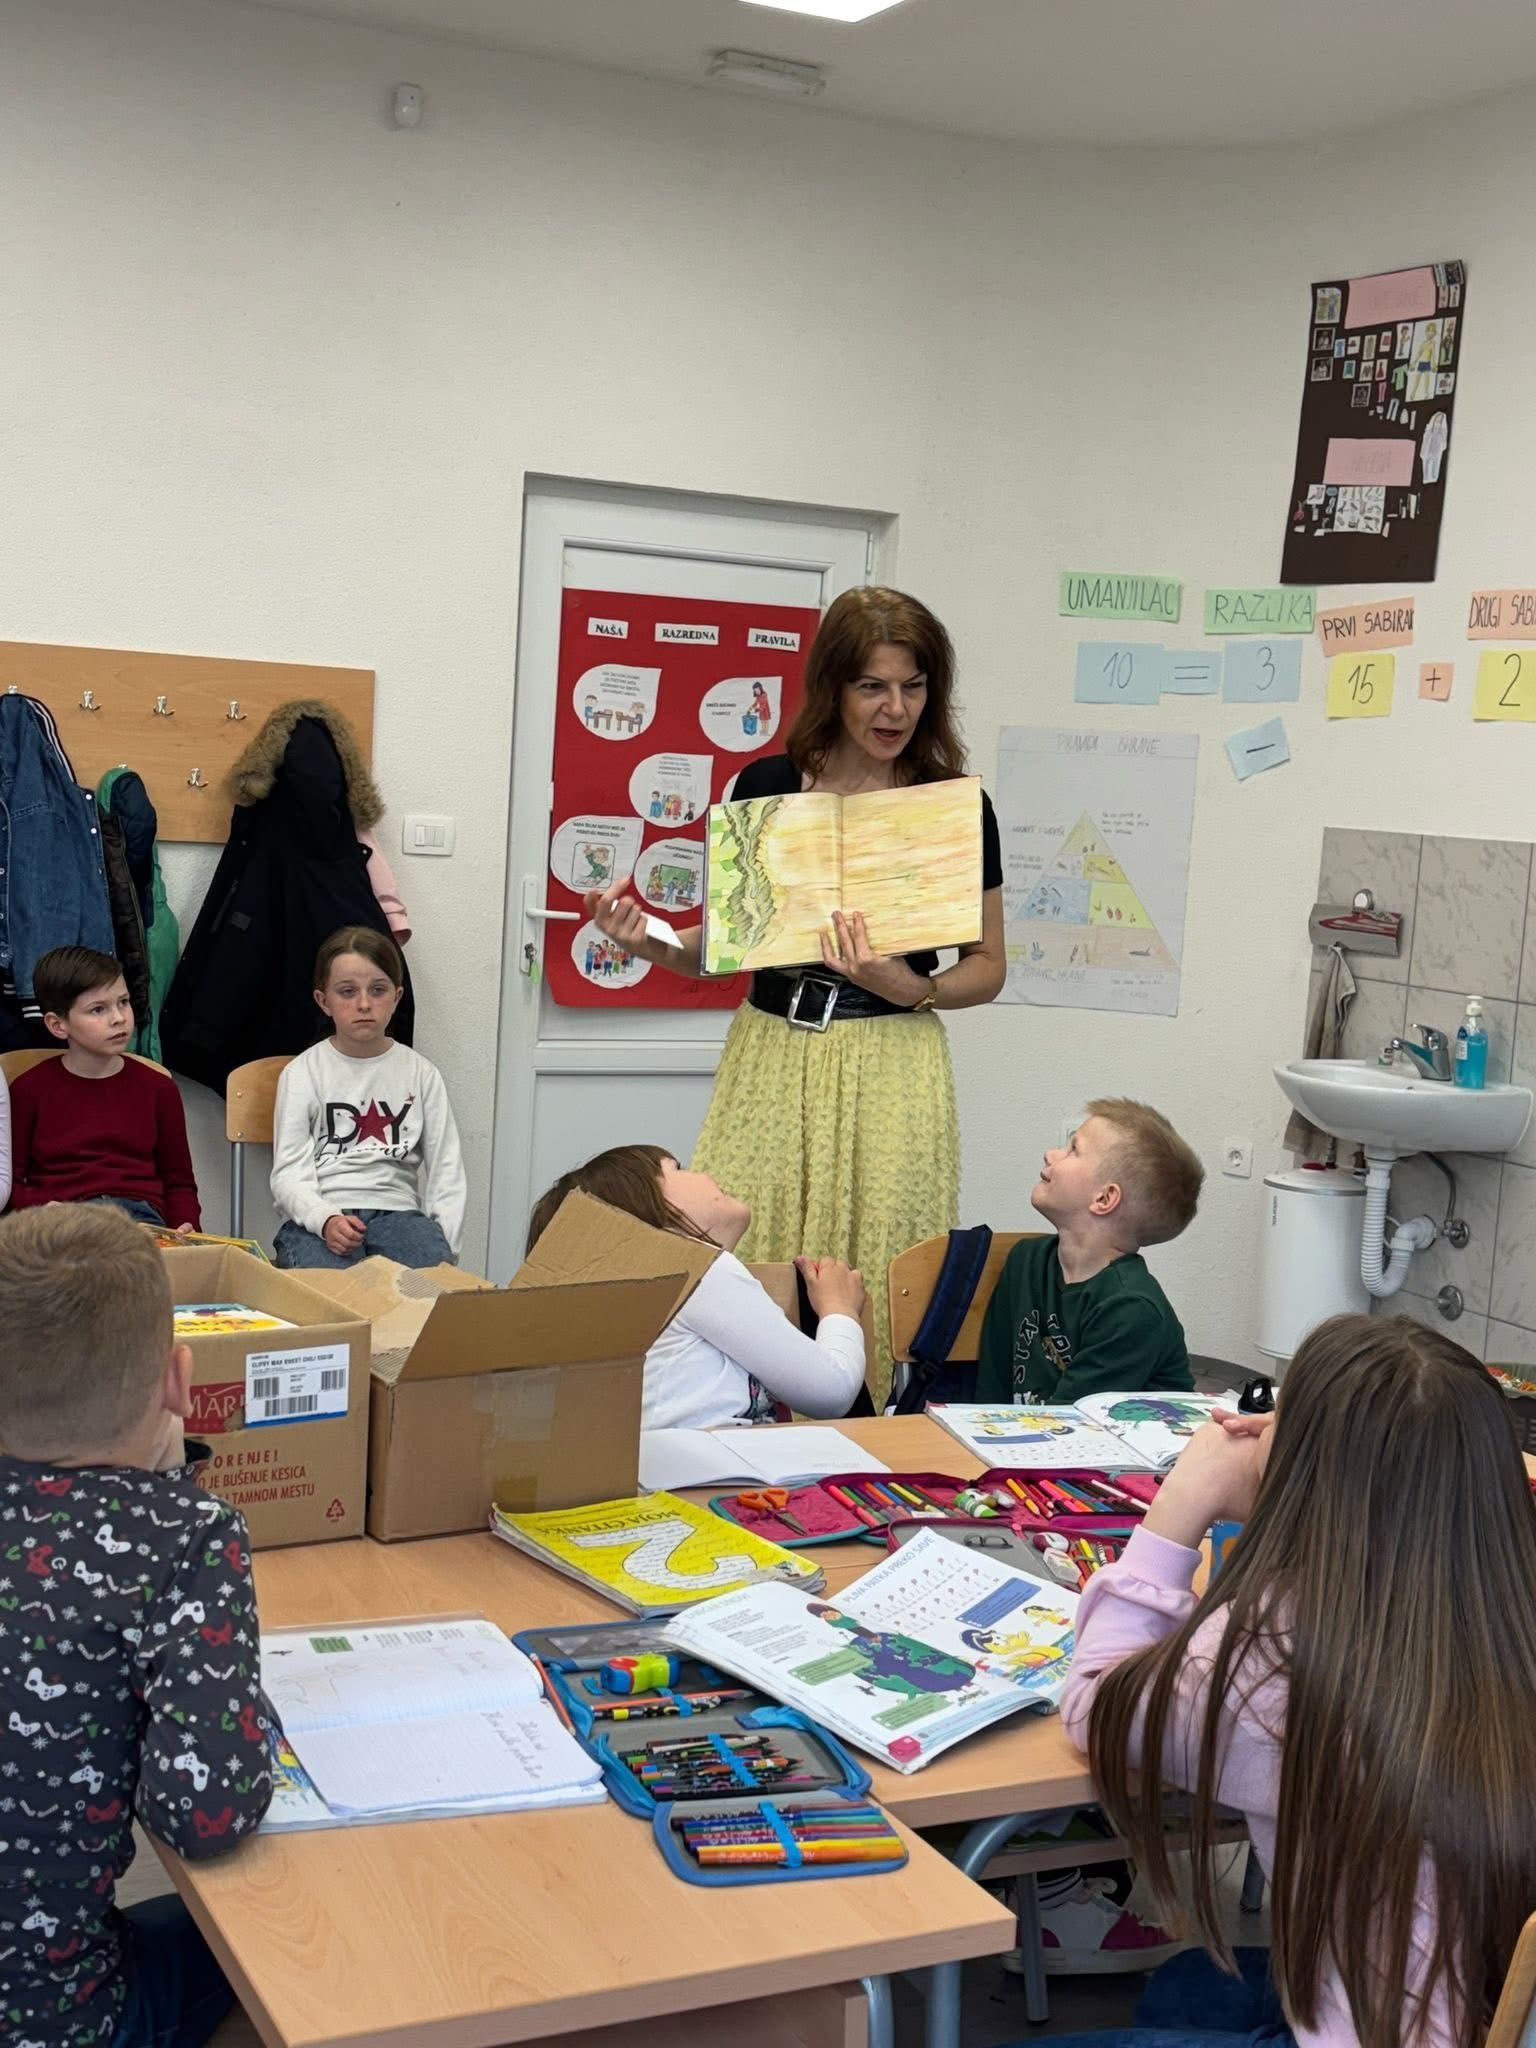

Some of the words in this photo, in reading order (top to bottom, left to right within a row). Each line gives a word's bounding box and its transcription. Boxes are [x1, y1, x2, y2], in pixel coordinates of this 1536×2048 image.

[1213, 592, 1313, 624] RAZLIKA
[1468, 595, 1503, 629] DRUGI
[595, 623, 624, 637] NAŠA
[662, 628, 716, 642] RAZREDNA
[755, 633, 796, 648] PRAVILA
[1321, 614, 1357, 641] PRVI
[1103, 652, 1133, 690] 10
[1256, 646, 1276, 691] 3
[1348, 663, 1375, 704] 15
[1499, 653, 1521, 706] 2
[223, 1469, 269, 1487] BUŠENJE
[271, 1465, 307, 1481] KESICA
[231, 1486, 278, 1504] TAMNOM
[280, 1483, 315, 1499] MESTU
